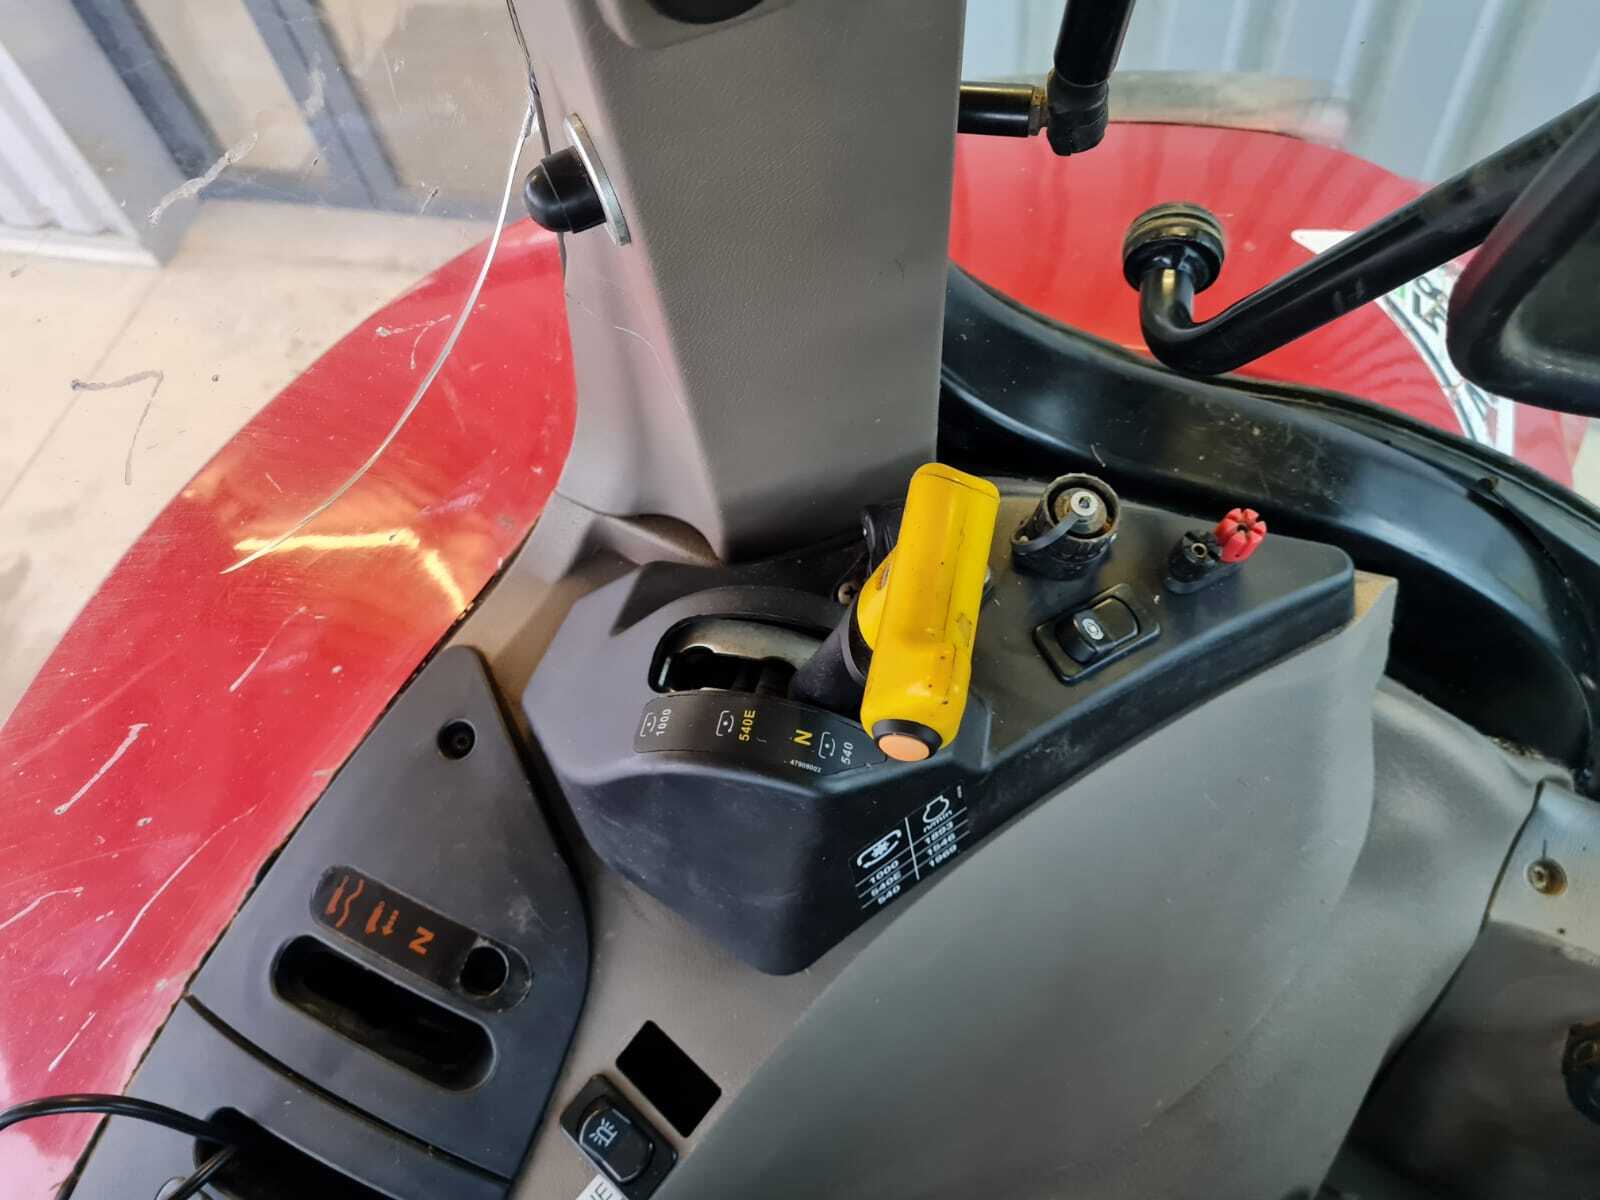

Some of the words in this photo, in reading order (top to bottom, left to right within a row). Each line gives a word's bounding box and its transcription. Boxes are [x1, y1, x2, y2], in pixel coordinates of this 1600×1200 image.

[655, 708, 672, 736] 1000
[738, 708, 756, 742] 540E
[793, 729, 813, 746] N
[841, 741, 853, 765] 540
[869, 859, 899, 884] 1000
[871, 871, 902, 897] 540E
[878, 885, 901, 905] 540
